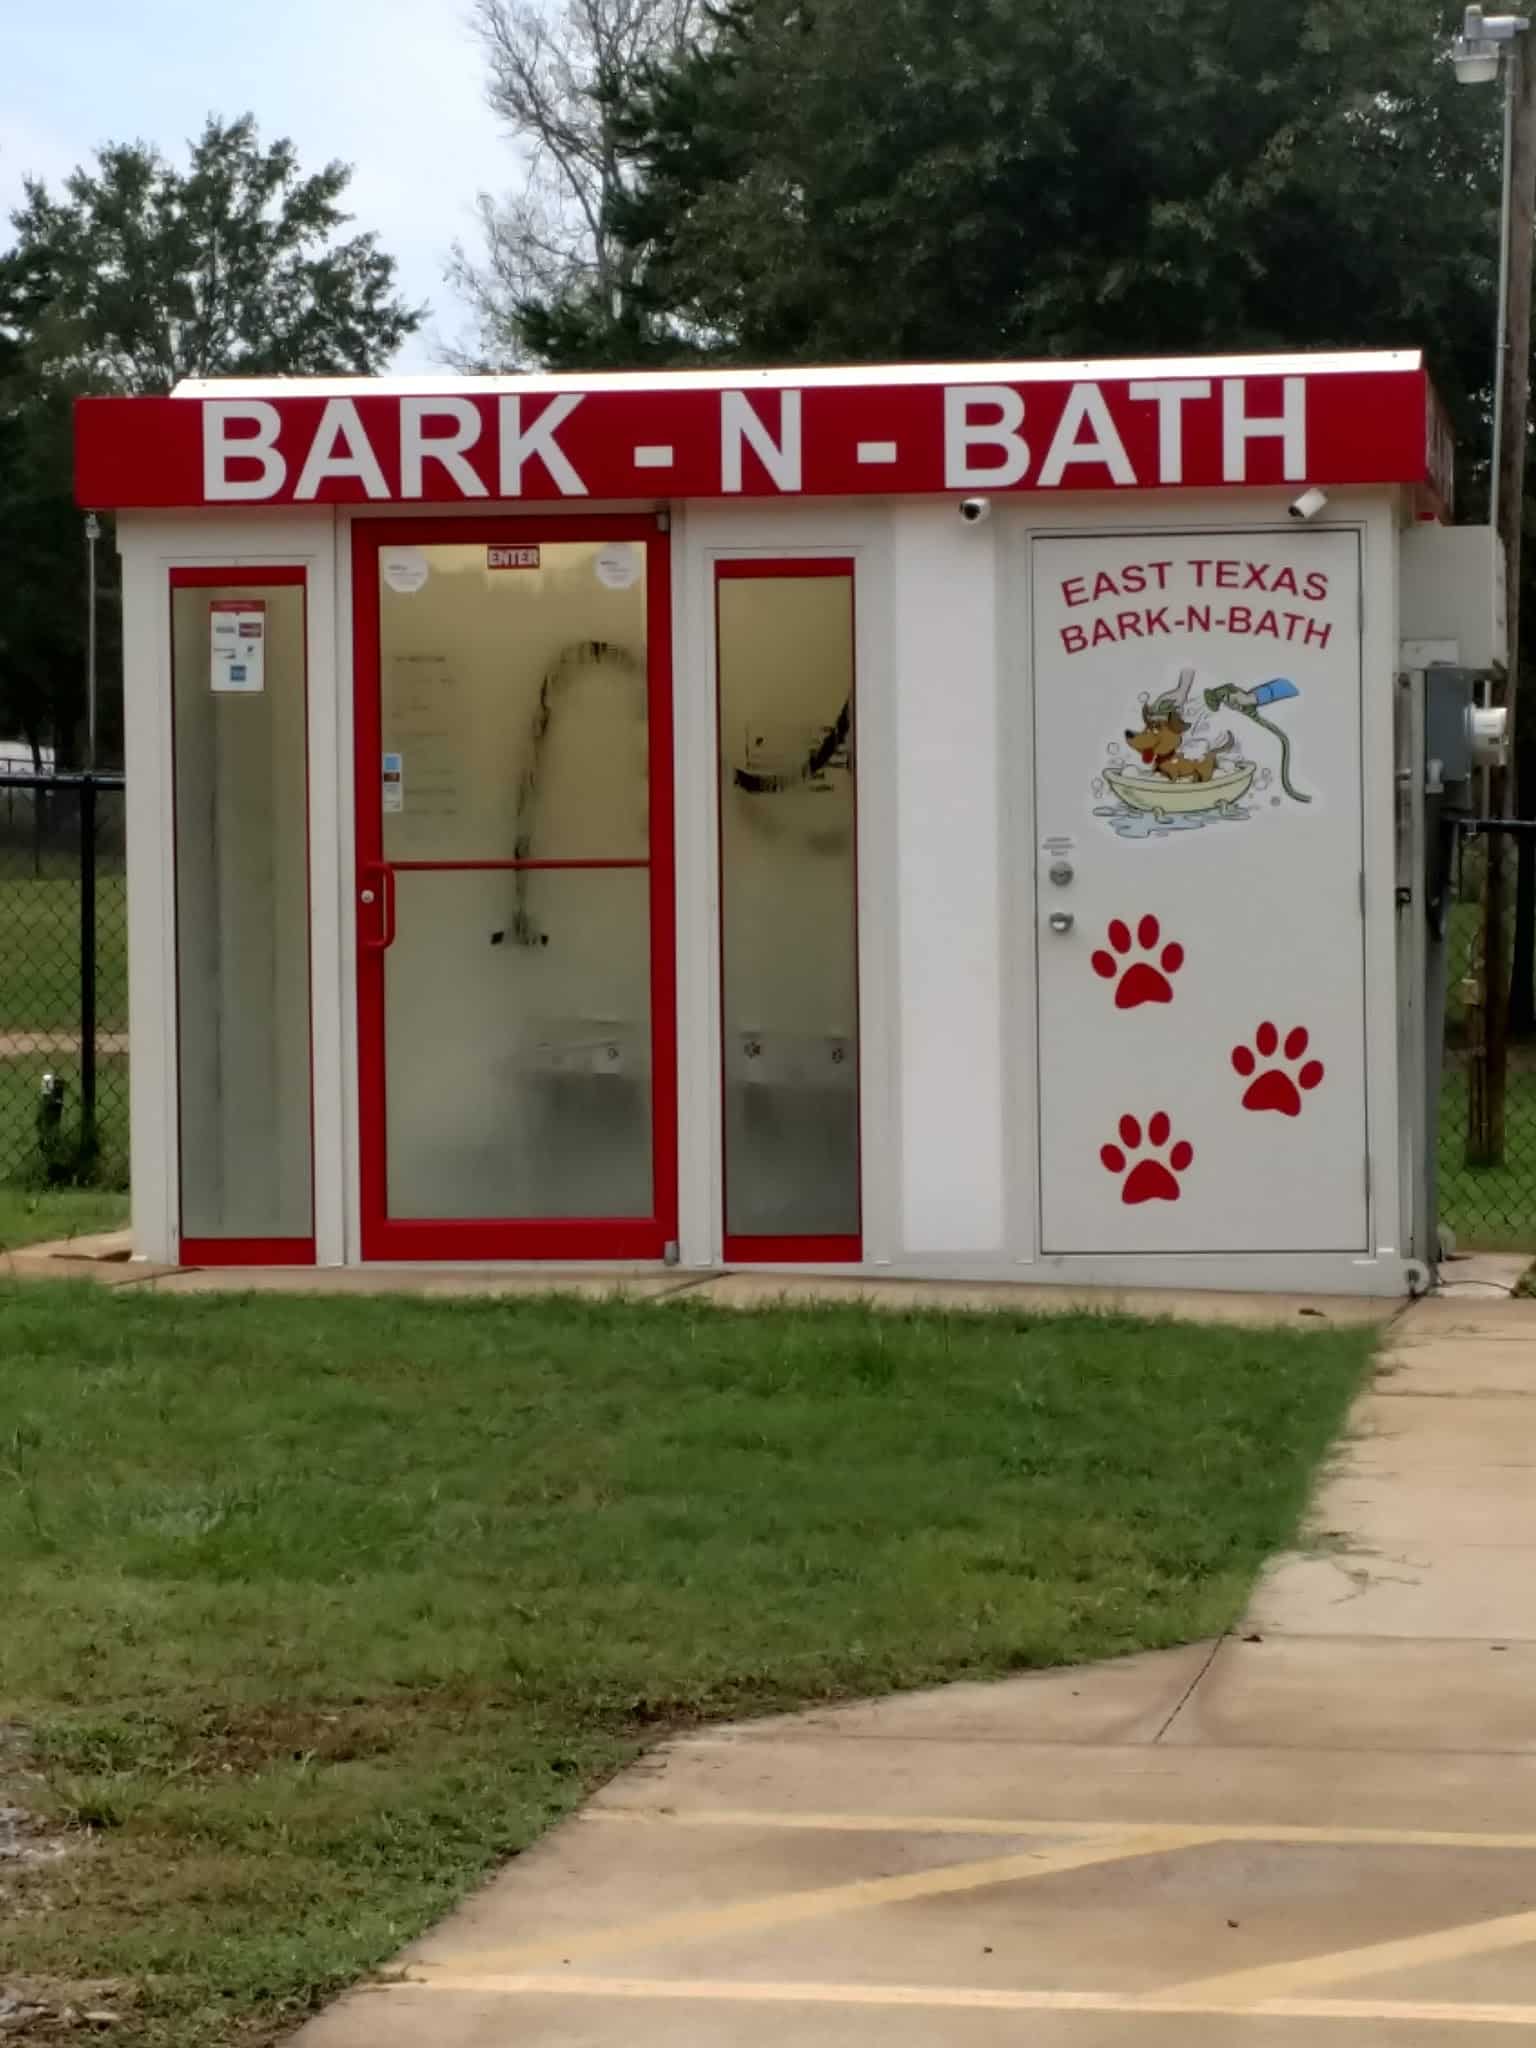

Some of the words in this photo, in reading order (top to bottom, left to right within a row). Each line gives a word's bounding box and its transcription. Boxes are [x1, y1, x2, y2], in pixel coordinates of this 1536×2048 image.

[203, 394, 588, 500] BARK
[722, 389, 802, 492] N
[944, 377, 1306, 489] BATH
[488, 549, 539, 566] ENTER
[1060, 561, 1173, 608] EAST
[1187, 560, 1328, 601] TEXAS
[1060, 605, 1332, 654] BARK-N-BATH
